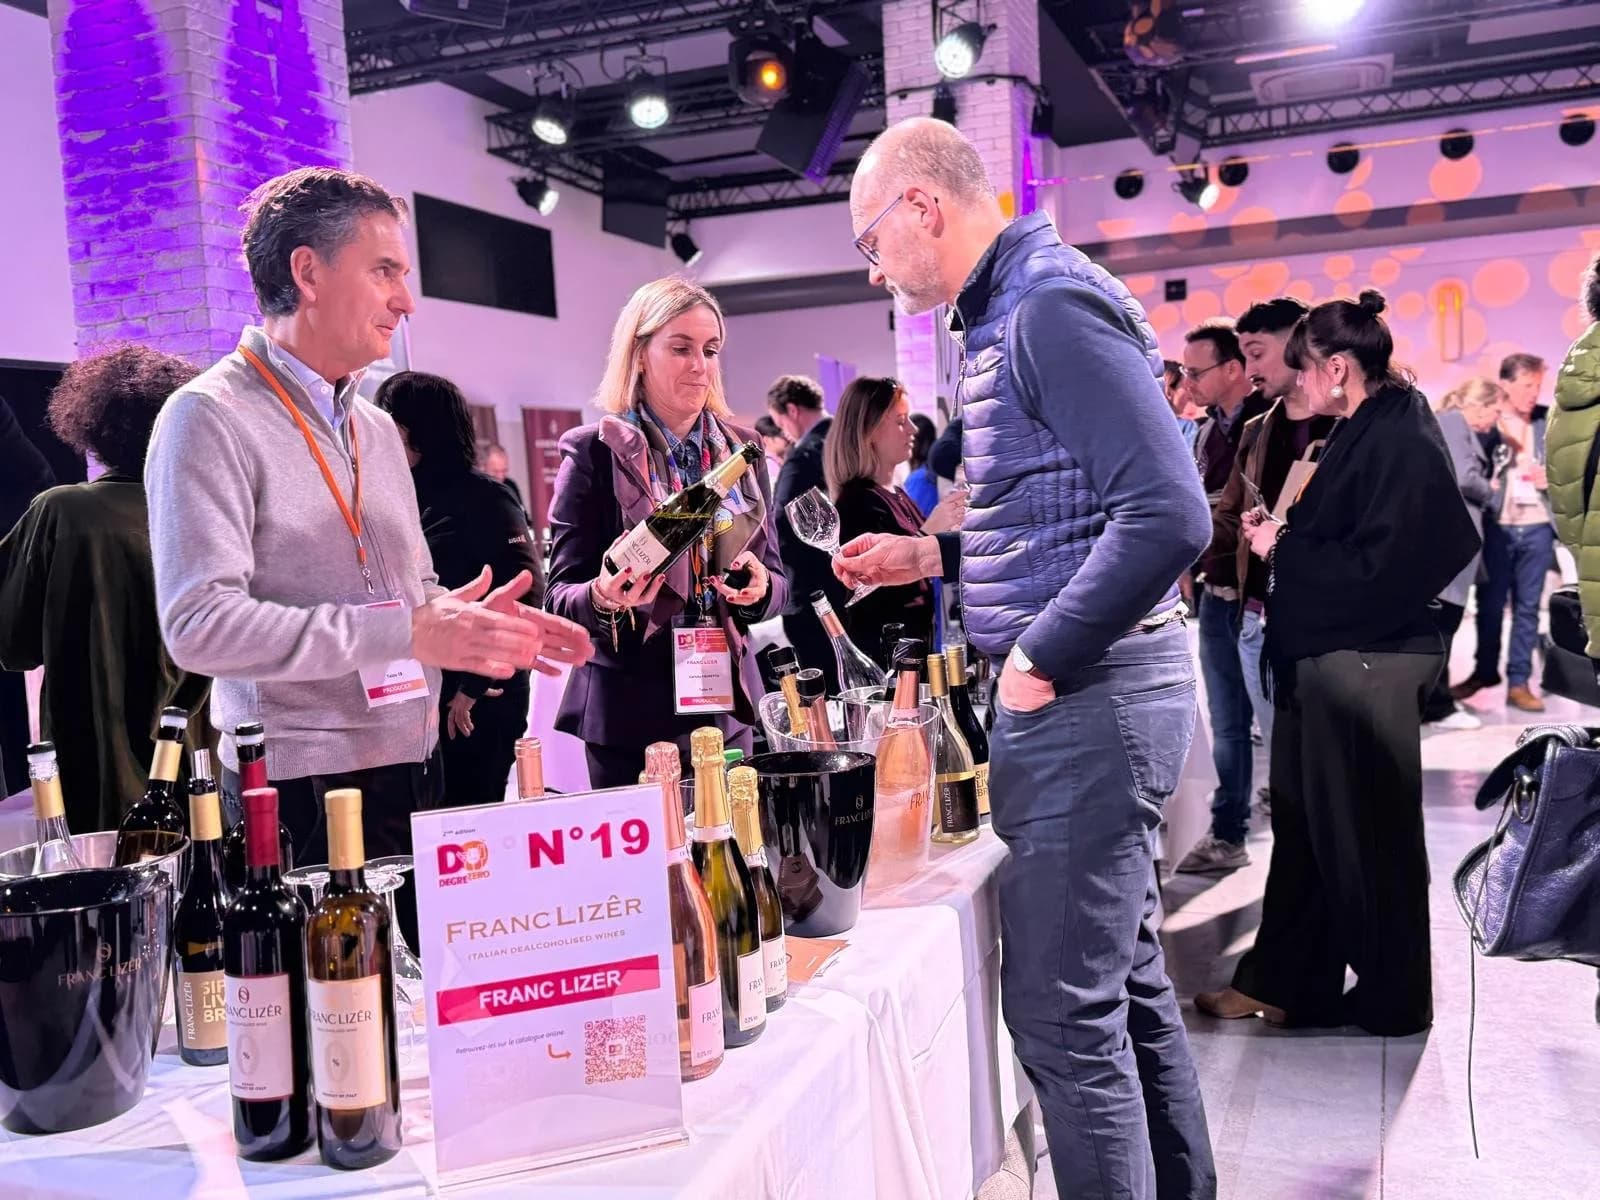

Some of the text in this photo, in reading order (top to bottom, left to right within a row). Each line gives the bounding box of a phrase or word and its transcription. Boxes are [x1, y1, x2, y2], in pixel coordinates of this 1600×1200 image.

[467, 929, 627, 961] ITALIAN DEALCOHOLISED WINES
[478, 969, 622, 1010] FRANC LIZER
